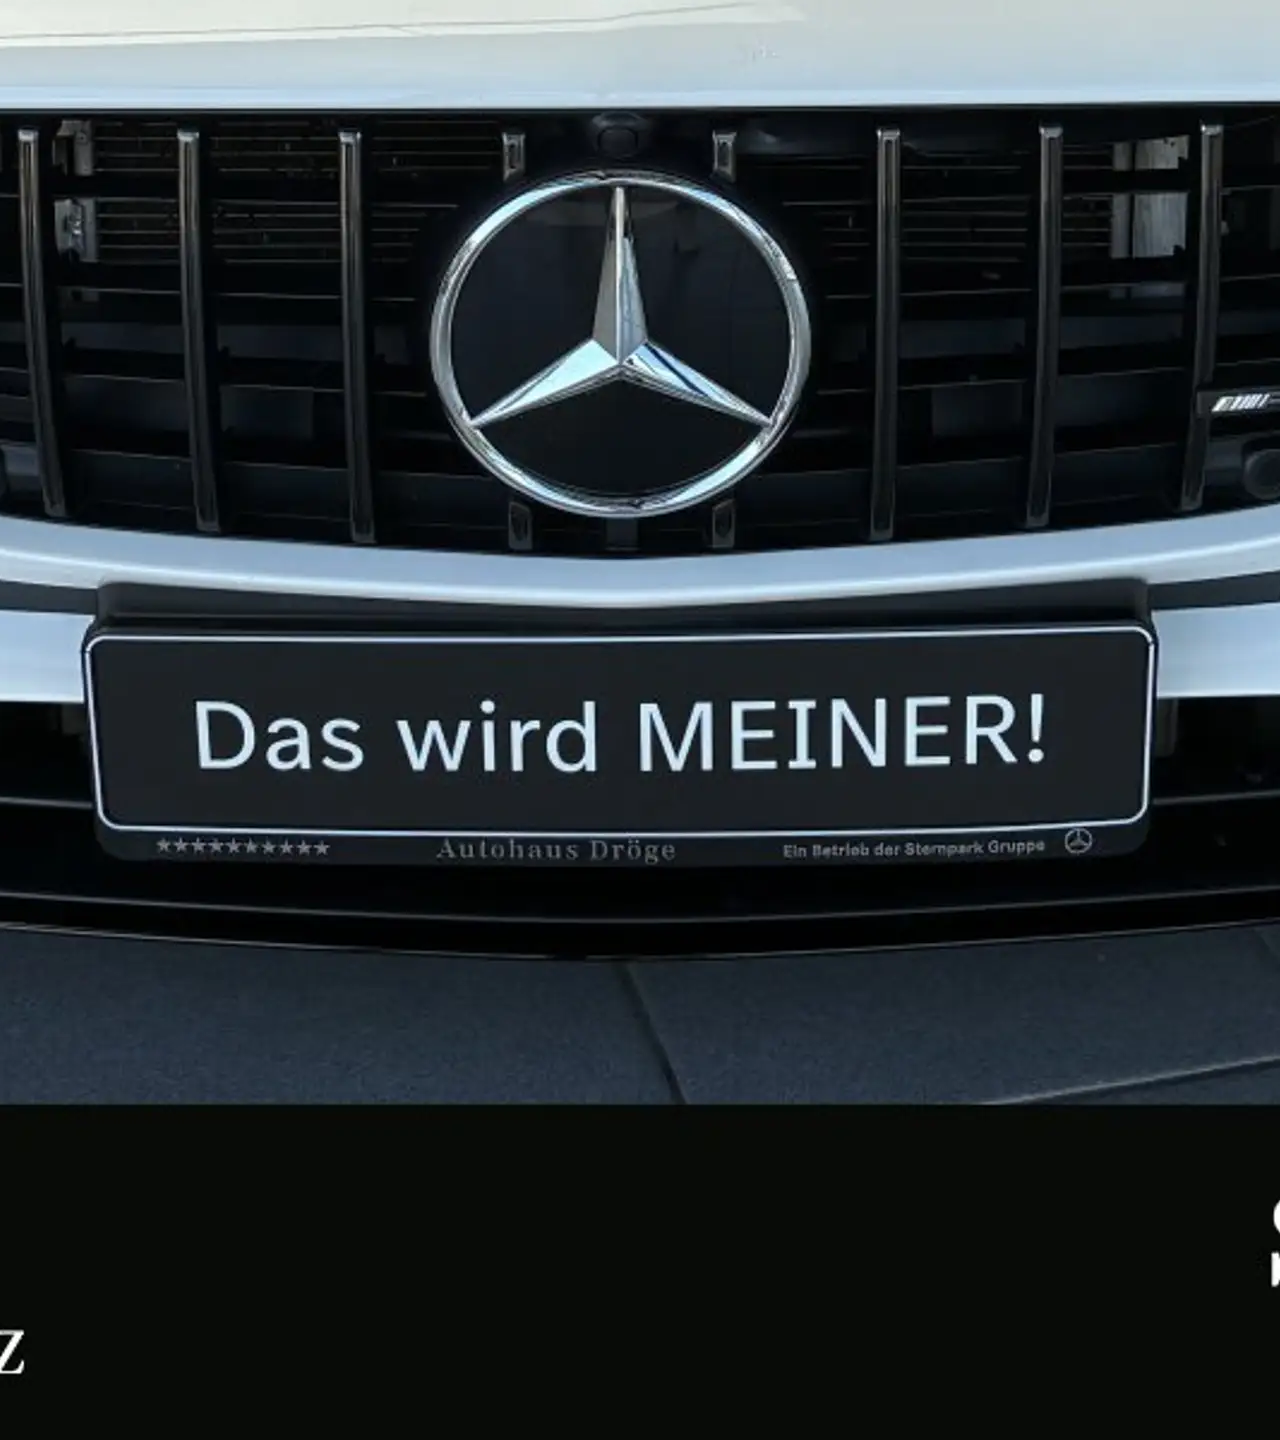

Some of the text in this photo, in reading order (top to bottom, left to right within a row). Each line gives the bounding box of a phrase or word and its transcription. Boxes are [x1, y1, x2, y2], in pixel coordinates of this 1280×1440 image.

[195, 692, 1046, 773] Das wird MEINER!
[435, 838, 676, 864] Autohaus Dröge
[783, 844, 807, 858] Ein
[811, 842, 870, 858] Betrieb
[873, 841, 901, 857] der
[987, 839, 1047, 859] Gruppe
